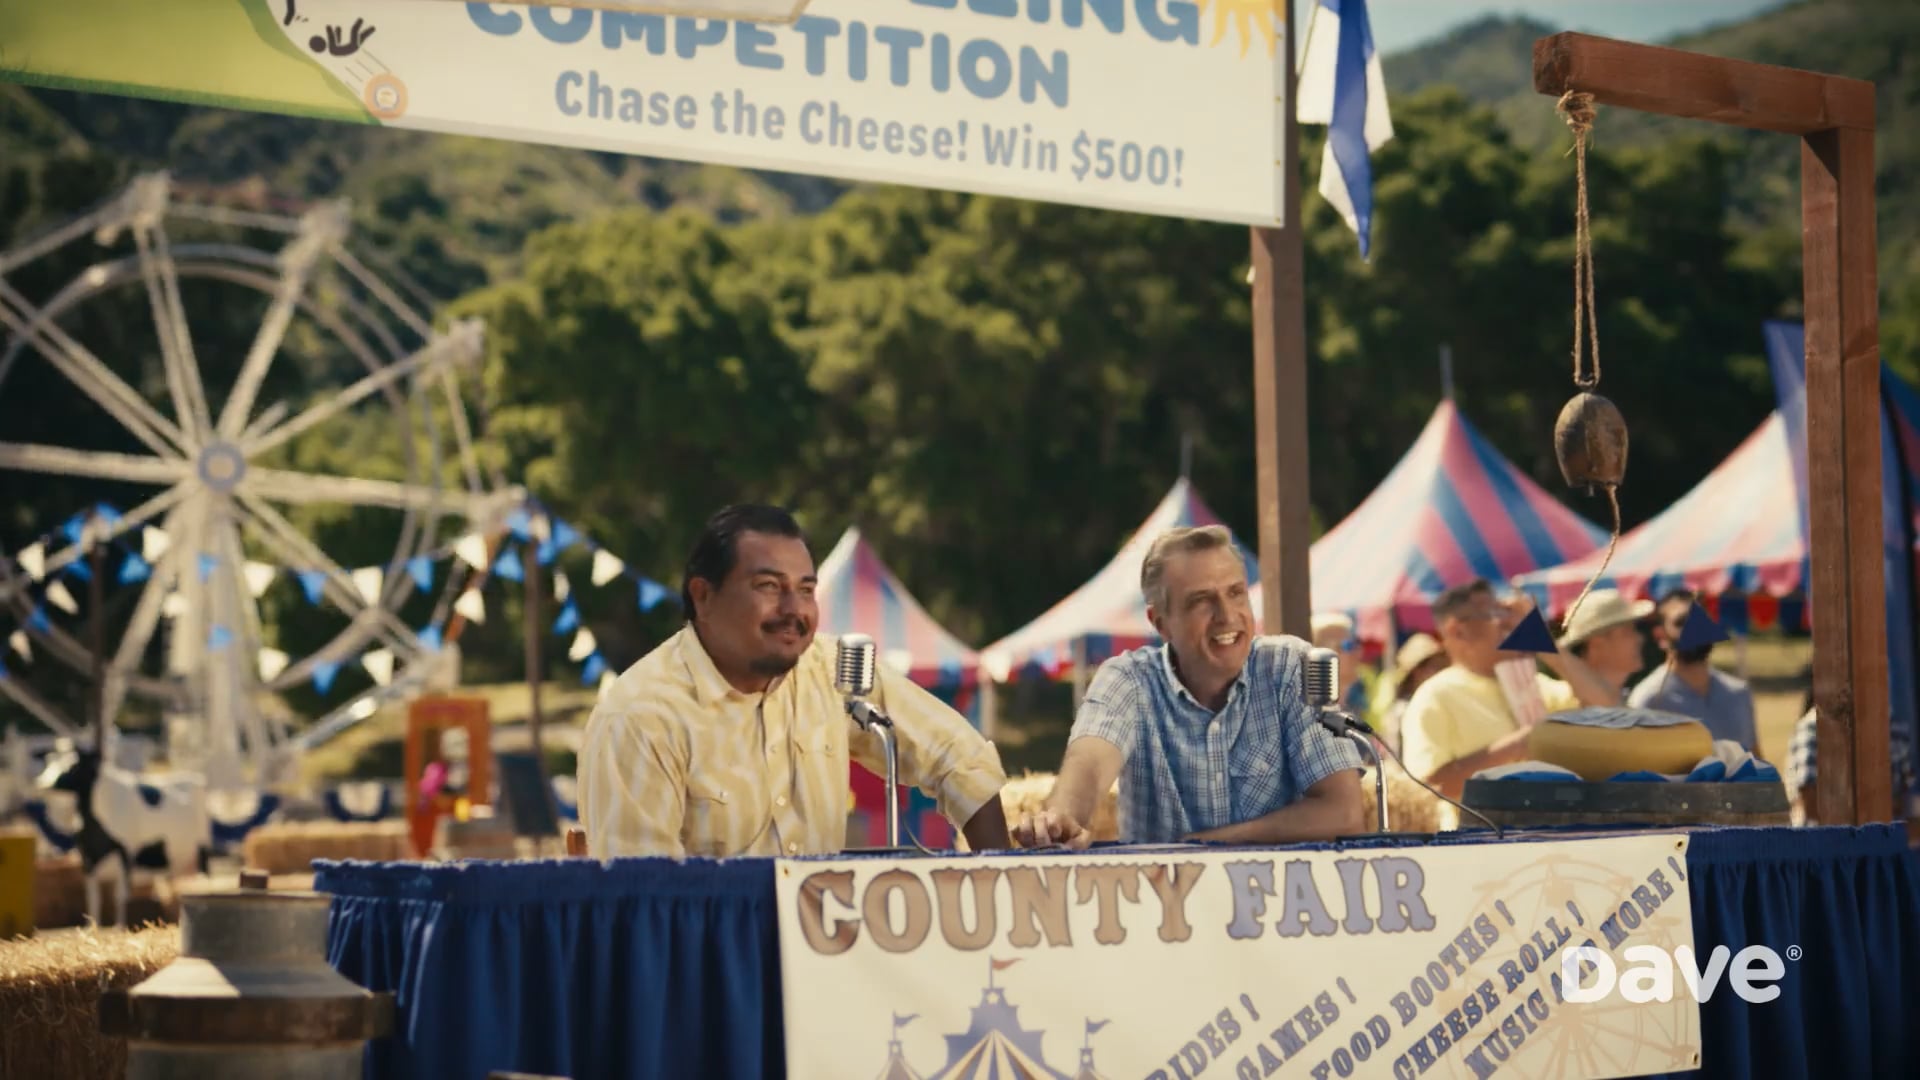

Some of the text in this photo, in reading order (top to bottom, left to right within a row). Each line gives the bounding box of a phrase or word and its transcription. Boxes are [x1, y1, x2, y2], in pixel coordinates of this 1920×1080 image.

[465, 3, 1069, 108] COMPETITION
[555, 70, 1184, 188] Chase the Cheese! Win $500!
[797, 855, 1436, 956] COUNTY FAIR
[1310, 1014, 1391, 1080] FOOD
[1393, 979, 1500, 1080] CHEESE
[1464, 988, 1550, 1080] MUSIC
